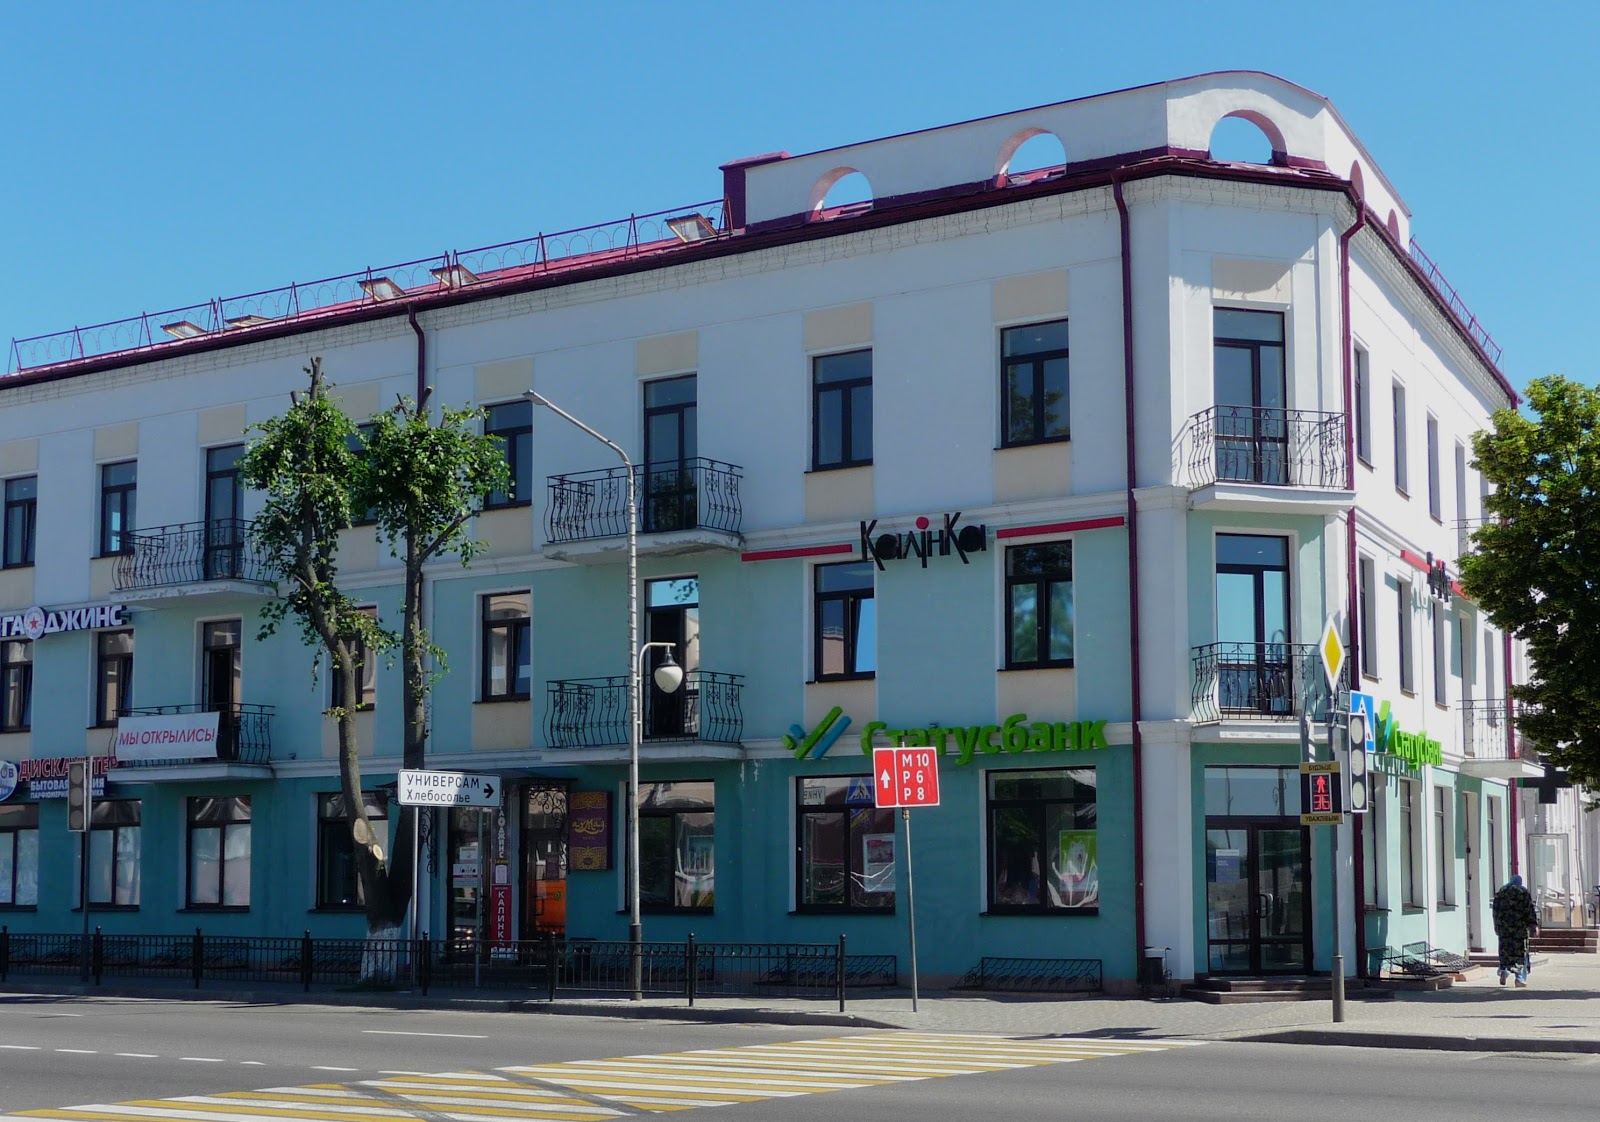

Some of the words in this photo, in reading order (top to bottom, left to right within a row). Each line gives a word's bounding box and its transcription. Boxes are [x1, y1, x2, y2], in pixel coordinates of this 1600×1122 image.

[0, 614, 25, 637] ГА
[44, 605, 123, 633] ДЖИНС
[119, 733, 139, 745] МЫ
[141, 729, 215, 744] ОТКРЫЛИСЬ!
[862, 713, 1108, 766] Статусбанк
[902, 754, 912, 766] М
[917, 753, 929, 766] 10
[19, 757, 118, 782] ДИСКАТЕР
[903, 771, 911, 783] Р
[916, 770, 924, 783] 6
[407, 774, 480, 789] УНИВЕРСАМ
[407, 790, 470, 804] Хлебосолье
[904, 788, 911, 801] Р
[917, 787, 925, 800] 8
[1313, 794, 1331, 810] 36
